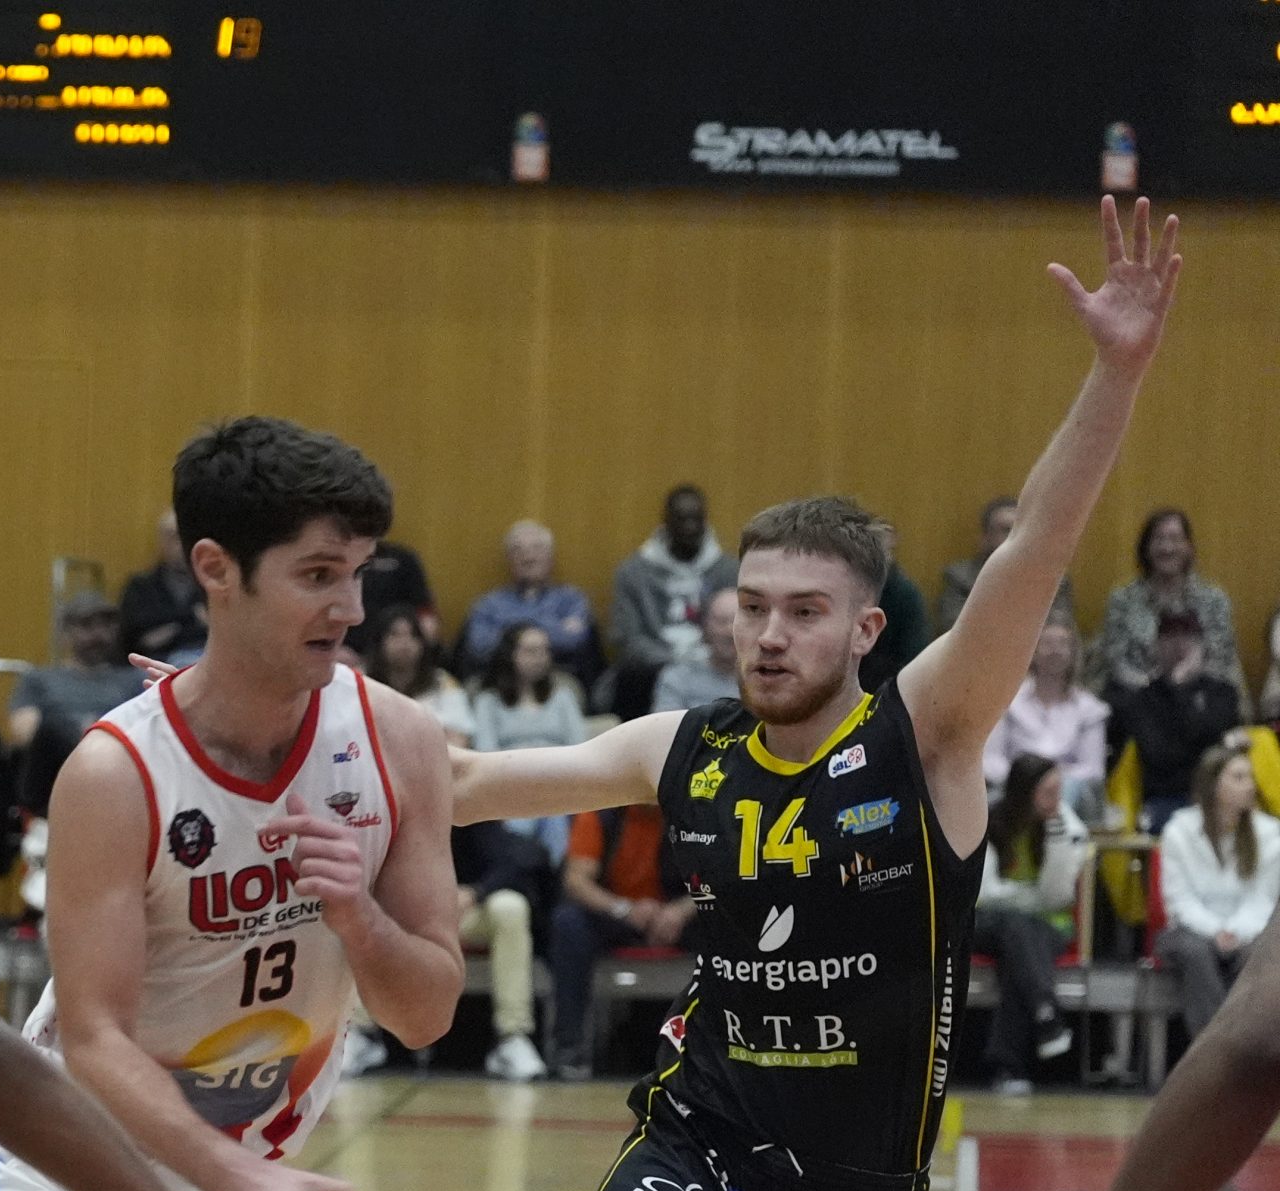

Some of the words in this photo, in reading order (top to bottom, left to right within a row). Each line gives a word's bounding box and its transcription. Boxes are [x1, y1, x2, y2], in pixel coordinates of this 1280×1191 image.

[691, 121, 960, 165] STRAMATEL
[843, 803, 892, 828] Alex
[734, 798, 820, 881] 14
[188, 857, 300, 933] LION
[858, 863, 915, 887] PROBAT
[243, 913, 270, 930] DE
[274, 899, 324, 923] GENE
[240, 938, 298, 1008] 13
